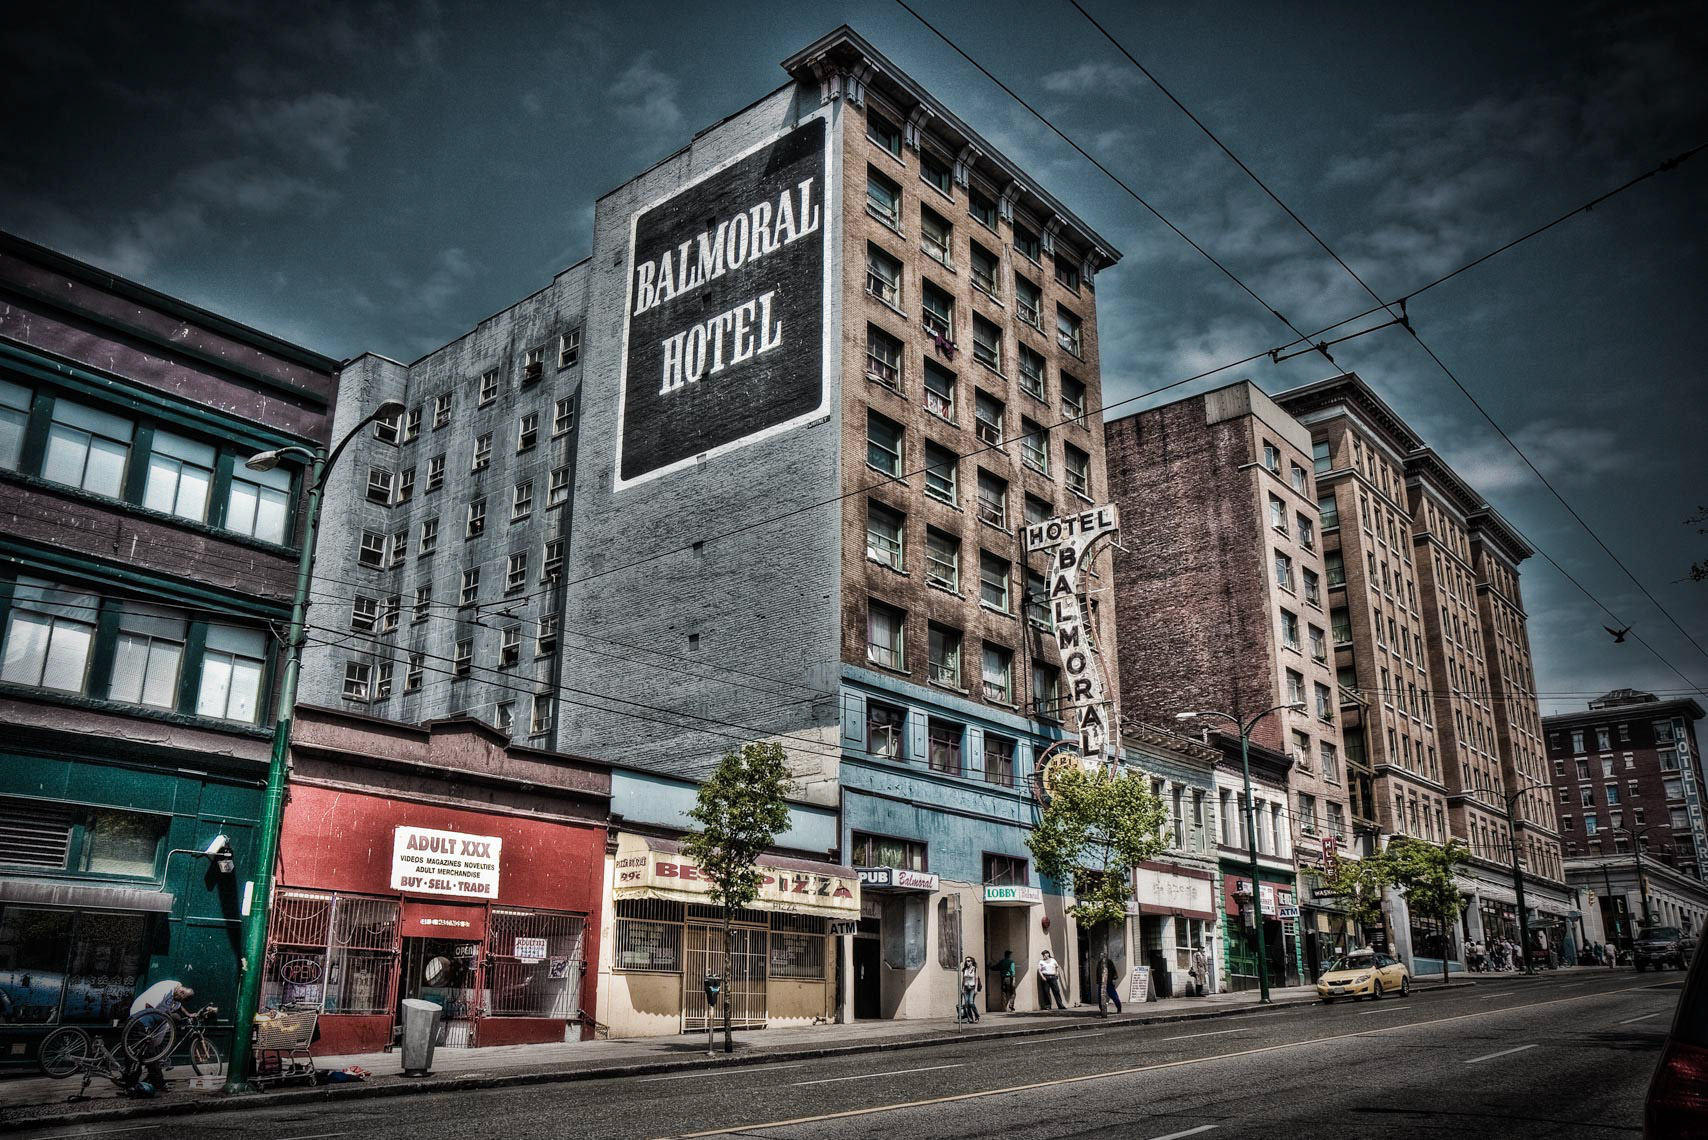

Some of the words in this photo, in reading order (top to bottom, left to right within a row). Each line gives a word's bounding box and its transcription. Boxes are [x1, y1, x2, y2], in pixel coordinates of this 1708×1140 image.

[633, 177, 819, 317] BALMORAL
[659, 290, 782, 395] HOTEL
[1029, 510, 1113, 546] HOTEL
[1052, 546, 1100, 757] BALMORAL
[1675, 726, 1696, 796] HOTEL
[406, 834, 457, 855] ADULT
[460, 840, 491, 859] XXX
[400, 855, 424, 864] VIDEOS
[426, 857, 462, 868] MAGAZINES
[464, 861, 495, 871] NOVELTIES
[415, 866, 435, 874] ADULT
[437, 868, 481, 879] MERCHANDISE
[655, 862, 716, 883] BES
[857, 870, 889, 884] PUB
[898, 870, 934, 889] Balmoral
[400, 876, 423, 888] BUY
[428, 878, 452, 891] SELL
[457, 881, 491, 894] TRADE
[987, 888, 1017, 899] LOBBY
[772, 902, 798, 912] PIZZA
[1280, 908, 1298, 917] ATM
[830, 922, 856, 935] ATM
[283, 964, 317, 980] OPEN
